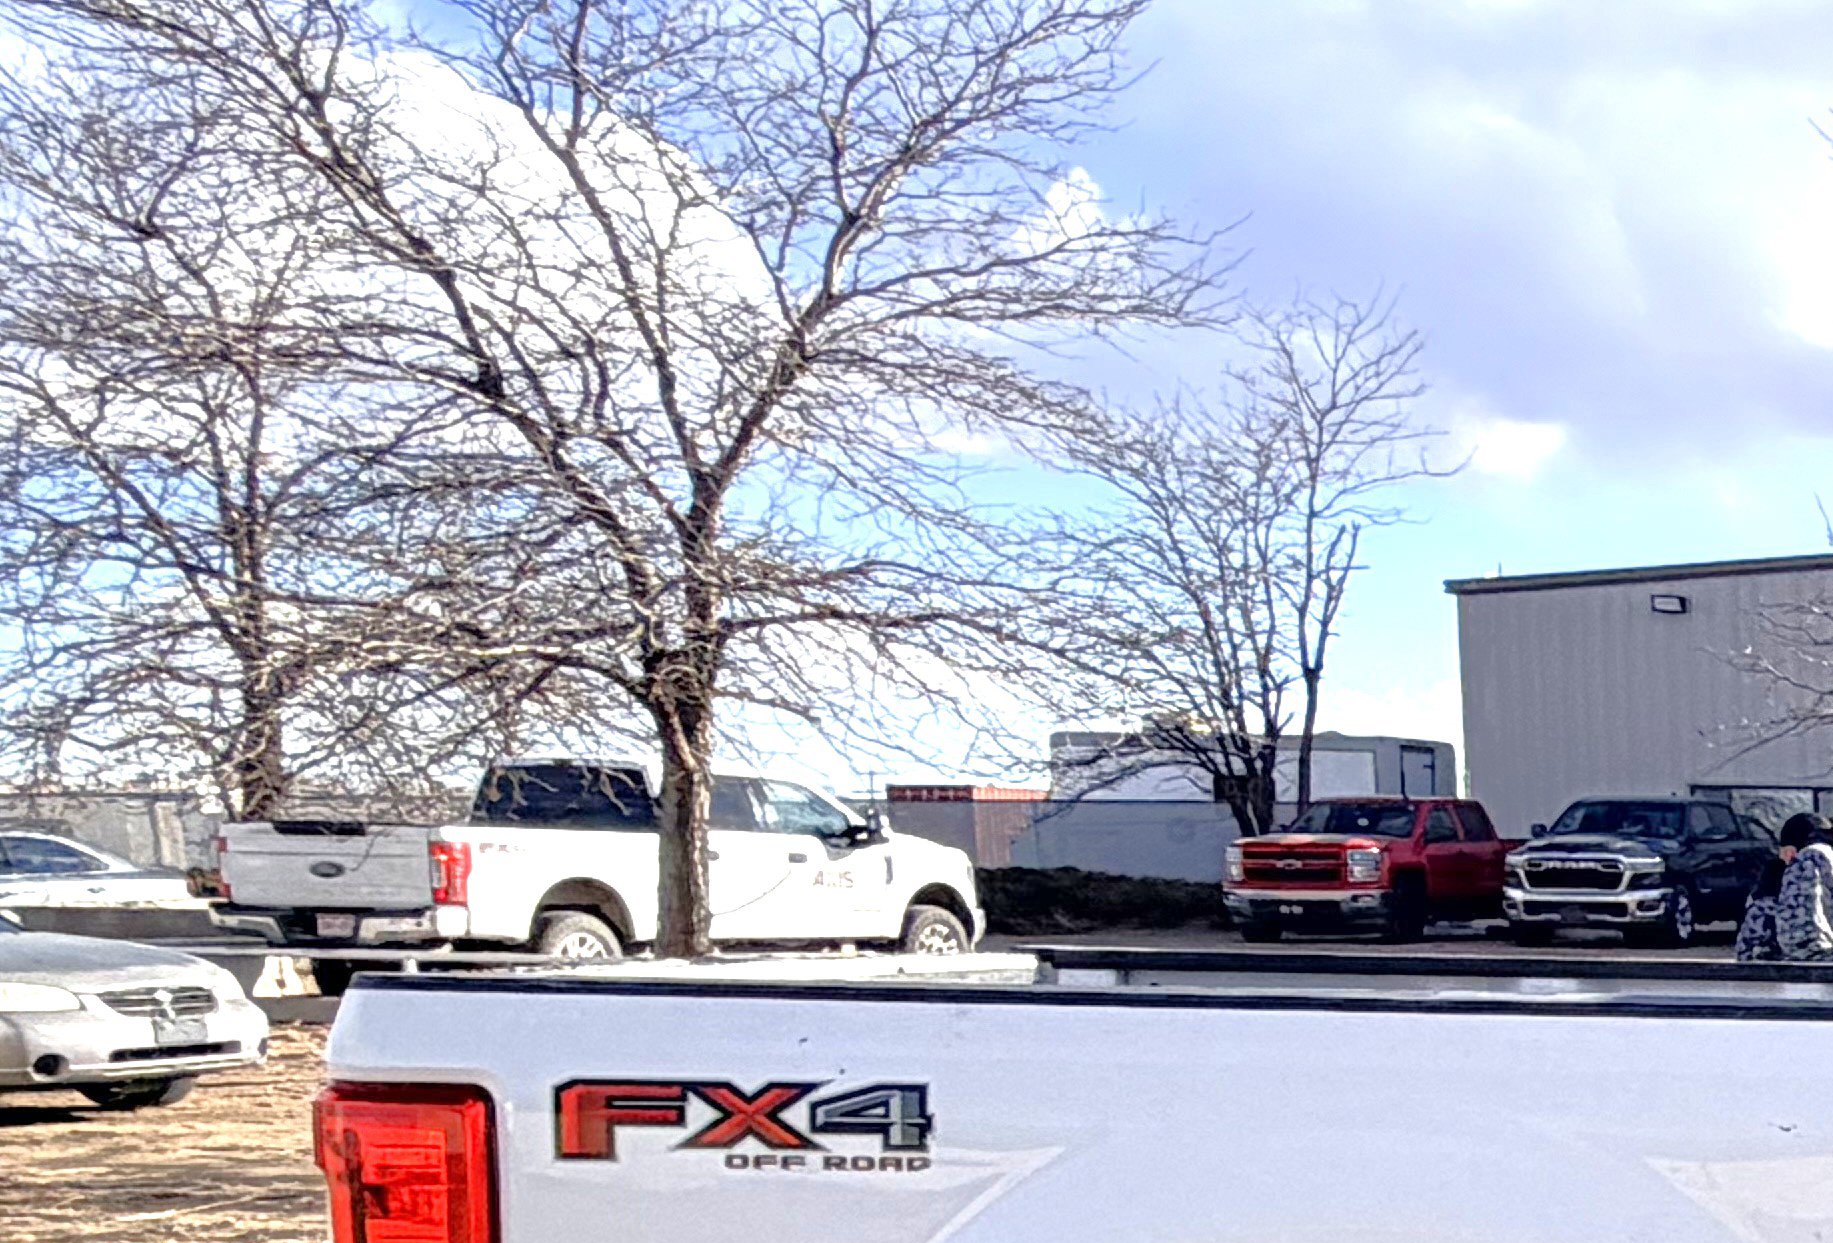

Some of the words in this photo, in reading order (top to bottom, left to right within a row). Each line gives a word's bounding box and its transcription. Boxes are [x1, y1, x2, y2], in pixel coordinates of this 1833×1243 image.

[554, 1078, 935, 1162] FX4
[724, 1153, 807, 1171] OFF
[822, 1154, 933, 1173] ROAD
